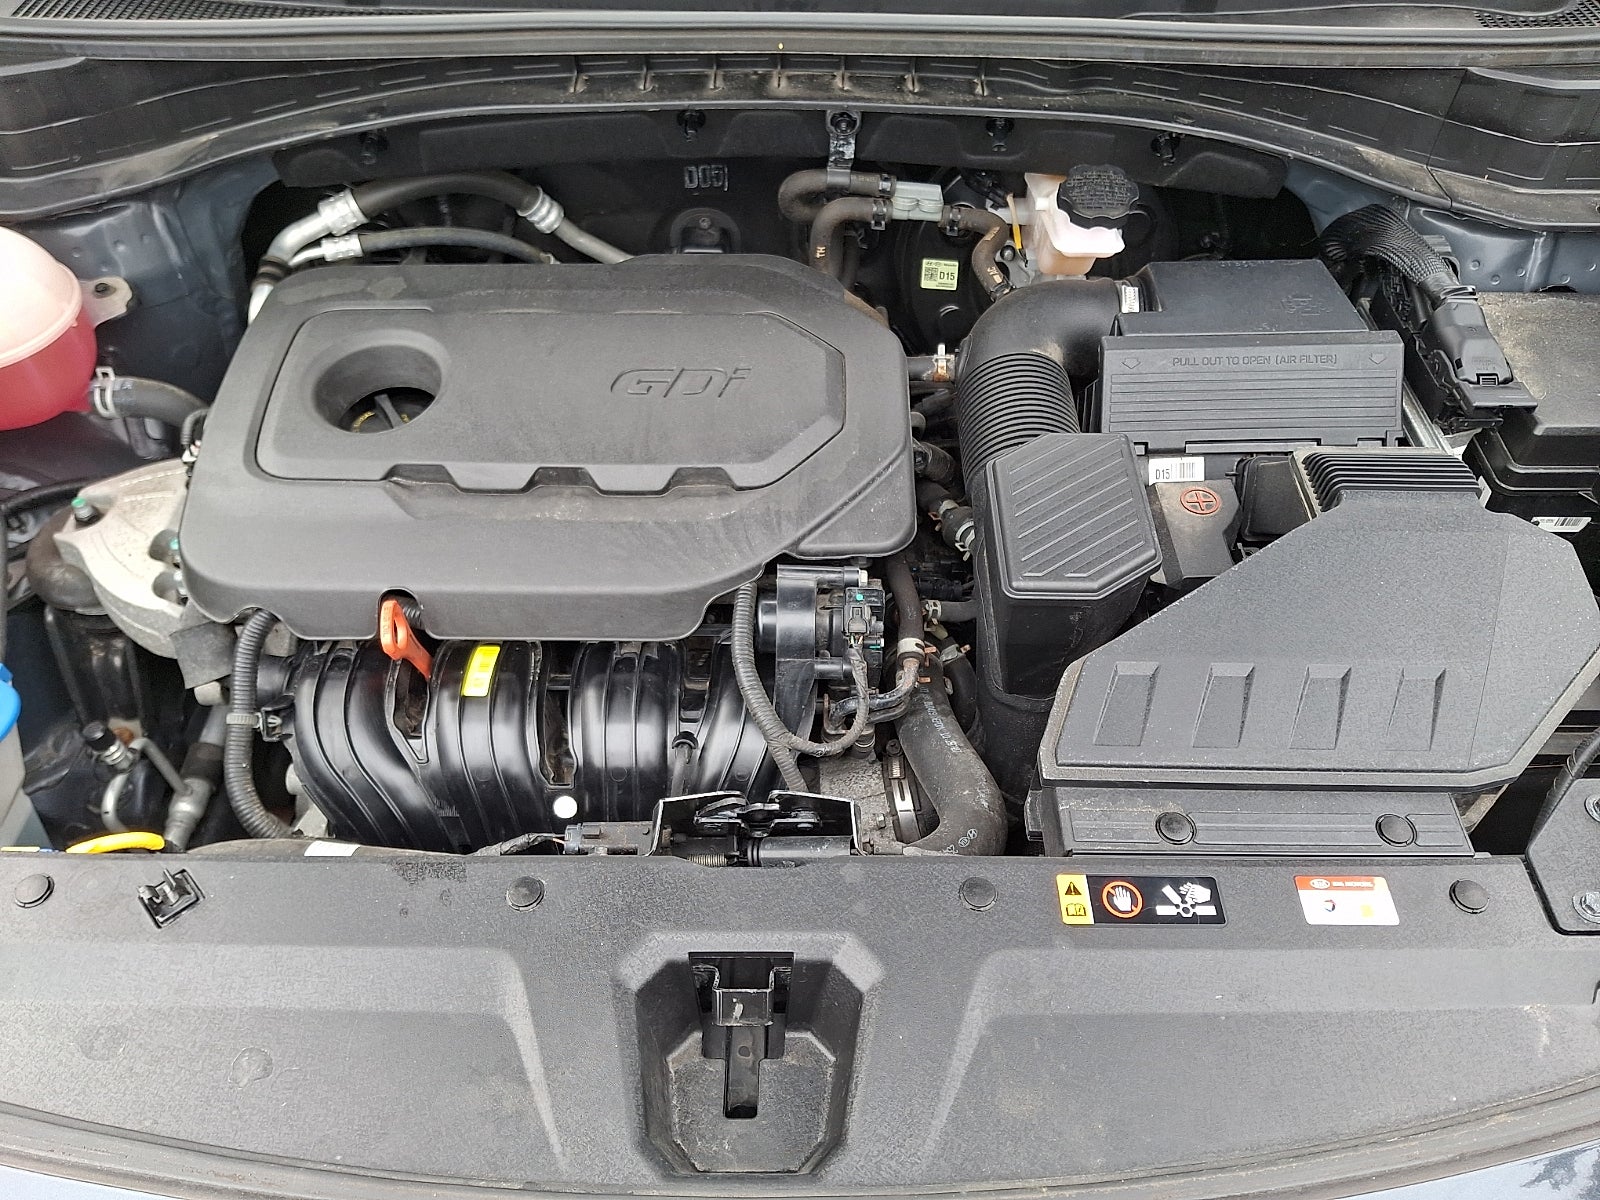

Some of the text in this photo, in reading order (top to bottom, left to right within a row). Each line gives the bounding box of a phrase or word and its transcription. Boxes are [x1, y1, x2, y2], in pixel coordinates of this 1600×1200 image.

[939, 271, 955, 281] D15
[1172, 354, 1337, 366] PULL OUT TO OPEN (AIR FILTER)
[1155, 468, 1171, 480] D15
